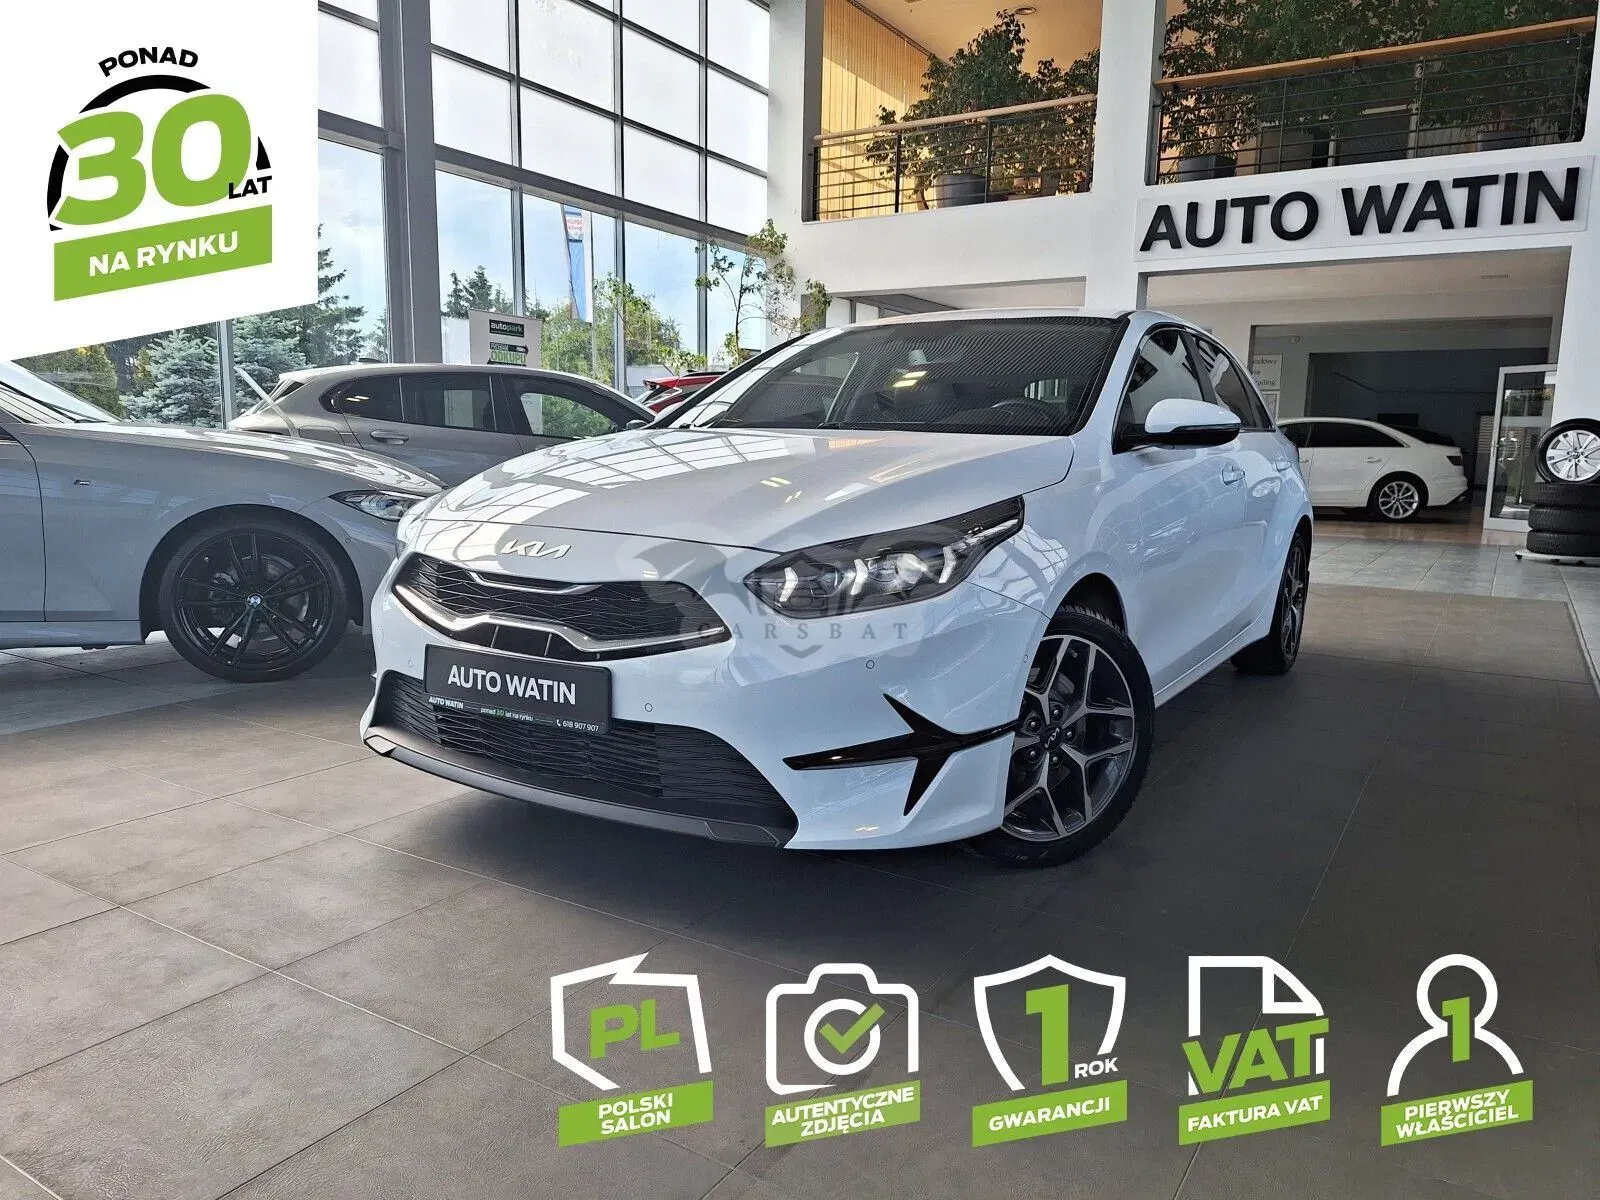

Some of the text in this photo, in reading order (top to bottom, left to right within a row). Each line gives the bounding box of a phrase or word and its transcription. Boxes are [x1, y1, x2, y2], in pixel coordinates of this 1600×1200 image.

[1139, 167, 1580, 252] AUTO WATIN
[490, 322, 523, 333] autopark
[500, 539, 572, 560] KIA
[447, 664, 576, 705] AUTO WATIN
[428, 696, 464, 709] AUTO WATIN
[480, 707, 496, 716] ponad
[496, 709, 505, 717] 30
[519, 713, 534, 722] rynku
[562, 720, 599, 732] 618 907 907
